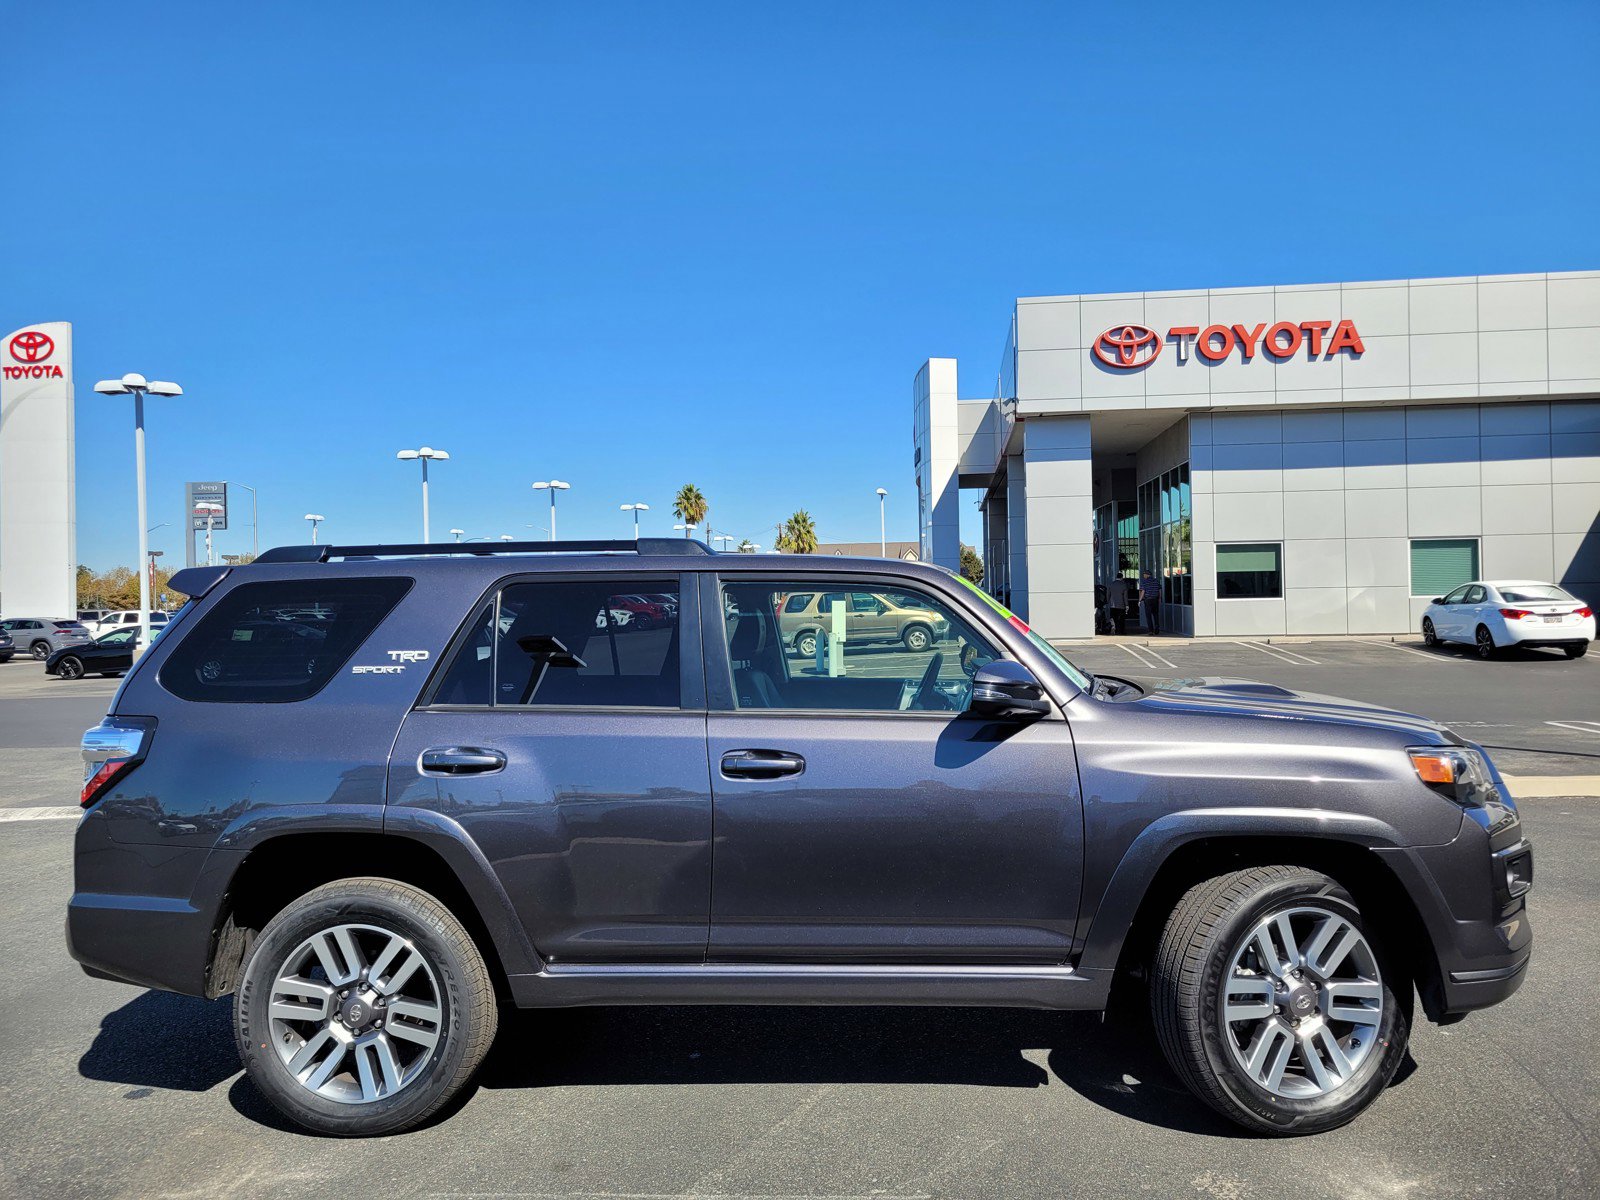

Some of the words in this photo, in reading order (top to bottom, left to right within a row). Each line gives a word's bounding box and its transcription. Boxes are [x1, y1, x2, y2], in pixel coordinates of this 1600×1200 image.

[1169, 319, 1365, 361] TOYOTA
[3, 365, 63, 380] TOYOTA
[387, 650, 429, 663] TRD
[352, 666, 406, 674] SPORT
